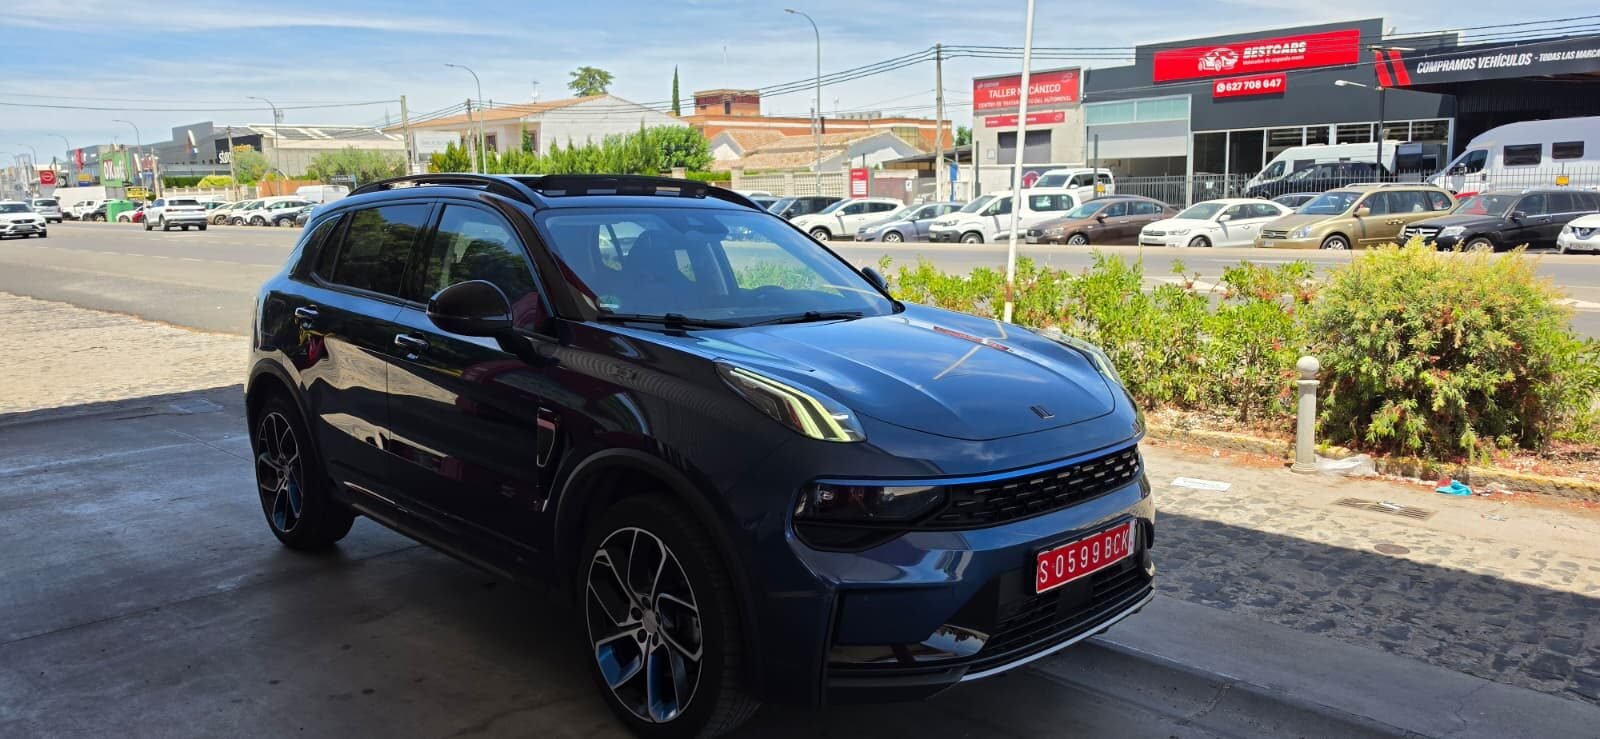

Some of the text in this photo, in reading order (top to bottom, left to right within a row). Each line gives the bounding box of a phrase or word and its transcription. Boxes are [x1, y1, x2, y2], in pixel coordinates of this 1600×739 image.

[1243, 41, 1306, 58] BESTCARS
[1416, 57, 1476, 74] COMPRAMOS
[1477, 52, 1533, 69] VEHÍCULOS
[1539, 51, 1562, 62] TODAS
[1561, 50, 1576, 60] LAS
[989, 83, 1061, 98] TALLER MCÁNICO
[1226, 78, 1282, 91] 627 708 647
[1040, 529, 1129, 583] S 0599 BCK
